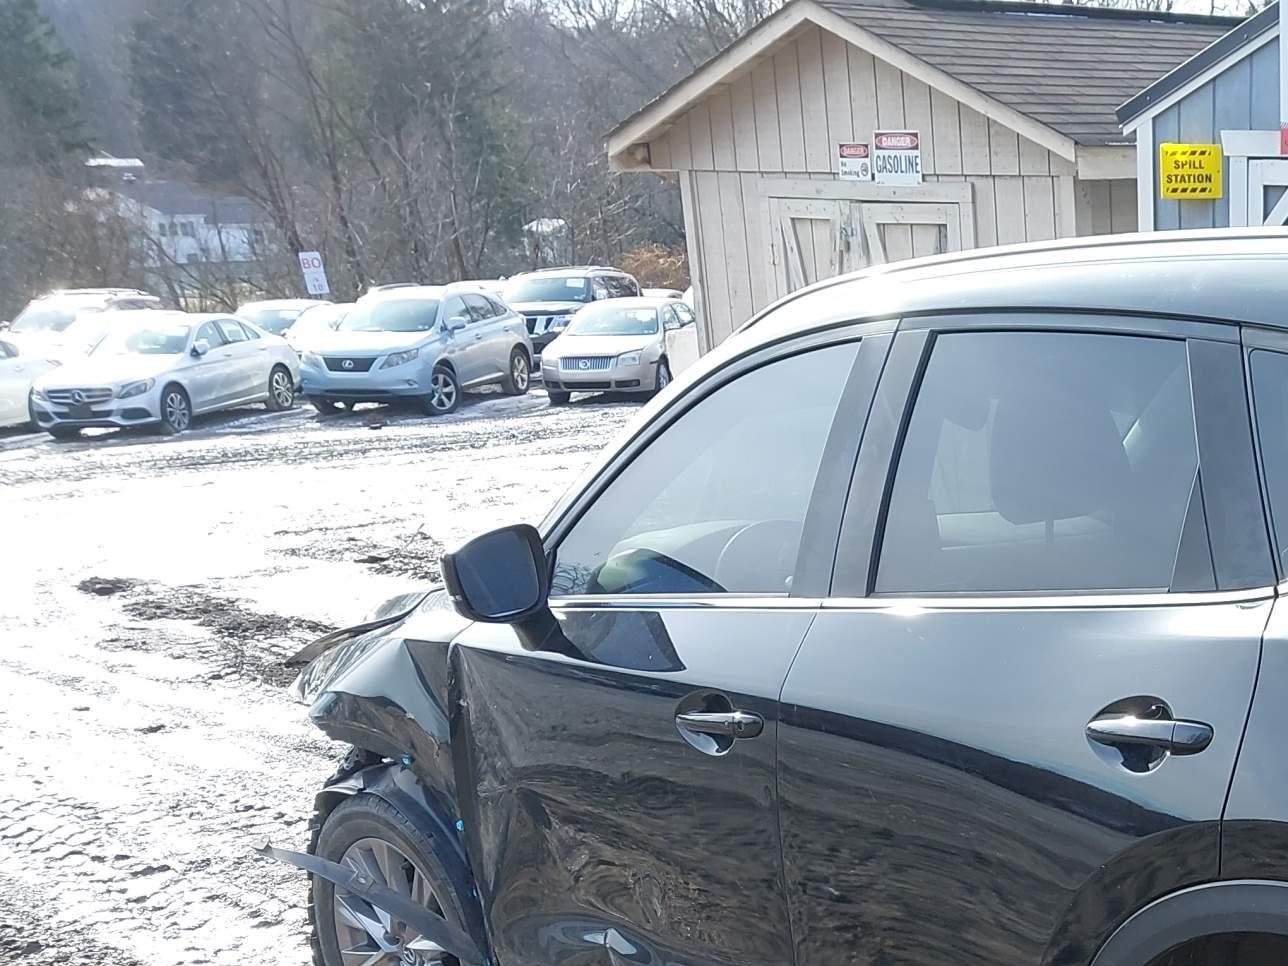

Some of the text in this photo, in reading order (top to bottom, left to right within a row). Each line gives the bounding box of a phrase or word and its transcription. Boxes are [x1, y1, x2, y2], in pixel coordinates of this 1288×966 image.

[882, 135, 911, 147] DANGER
[875, 155, 920, 174] GASOLINE
[1173, 159, 1206, 170] SPILL
[1166, 173, 1213, 184] STATION
